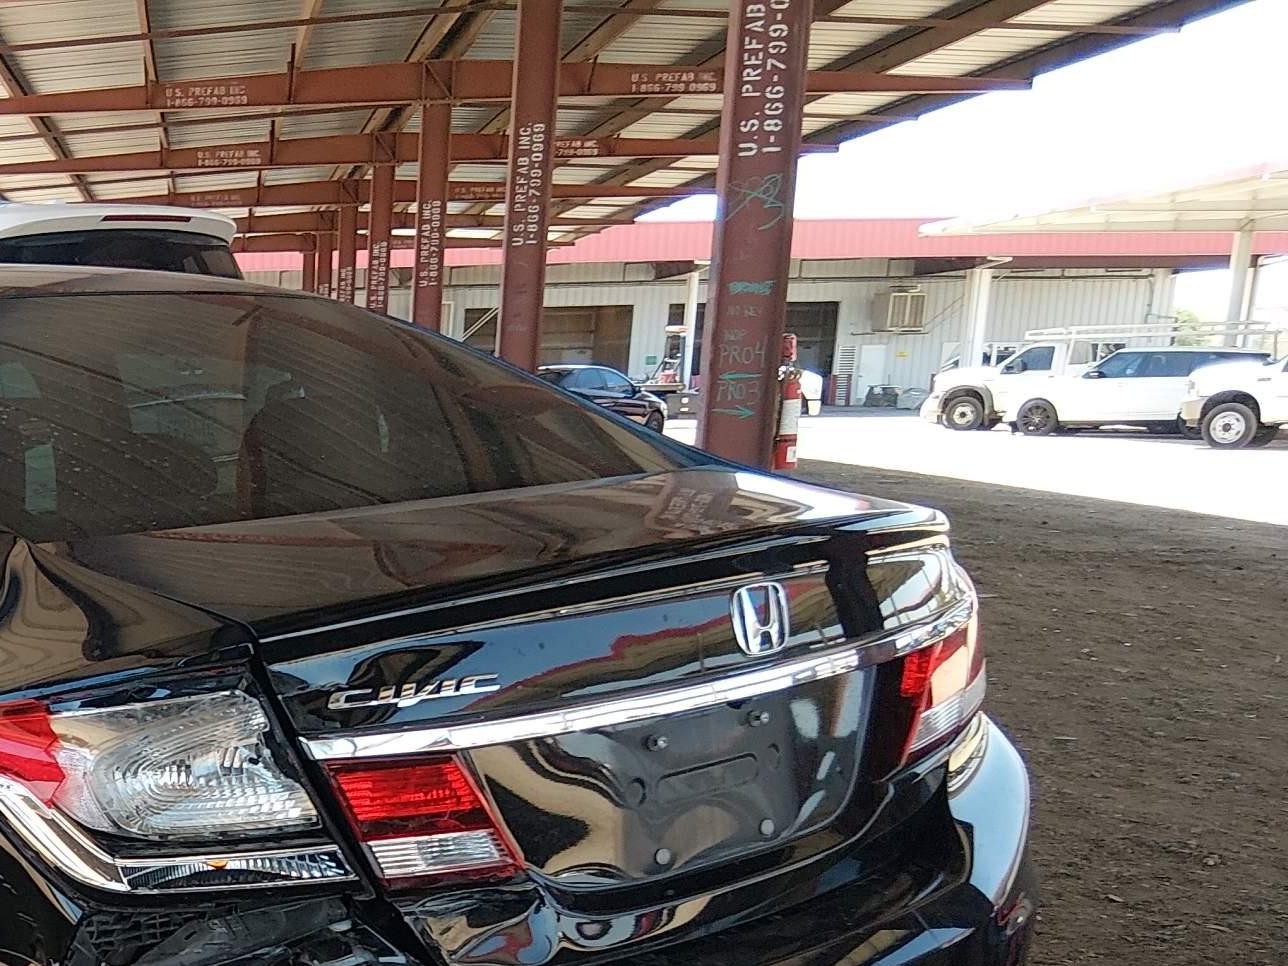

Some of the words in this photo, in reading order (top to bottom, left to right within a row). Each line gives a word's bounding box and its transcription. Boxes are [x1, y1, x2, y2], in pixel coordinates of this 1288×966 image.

[741, 3, 766, 97] PREFAB
[188, 85, 227, 97] PREFAB
[517, 122, 532, 150] INC.
[738, 111, 760, 156] U.S.
[514, 156, 530, 211] PREFAB
[512, 219, 526, 246] U.S.
[327, 673, 501, 710] CIVIC
